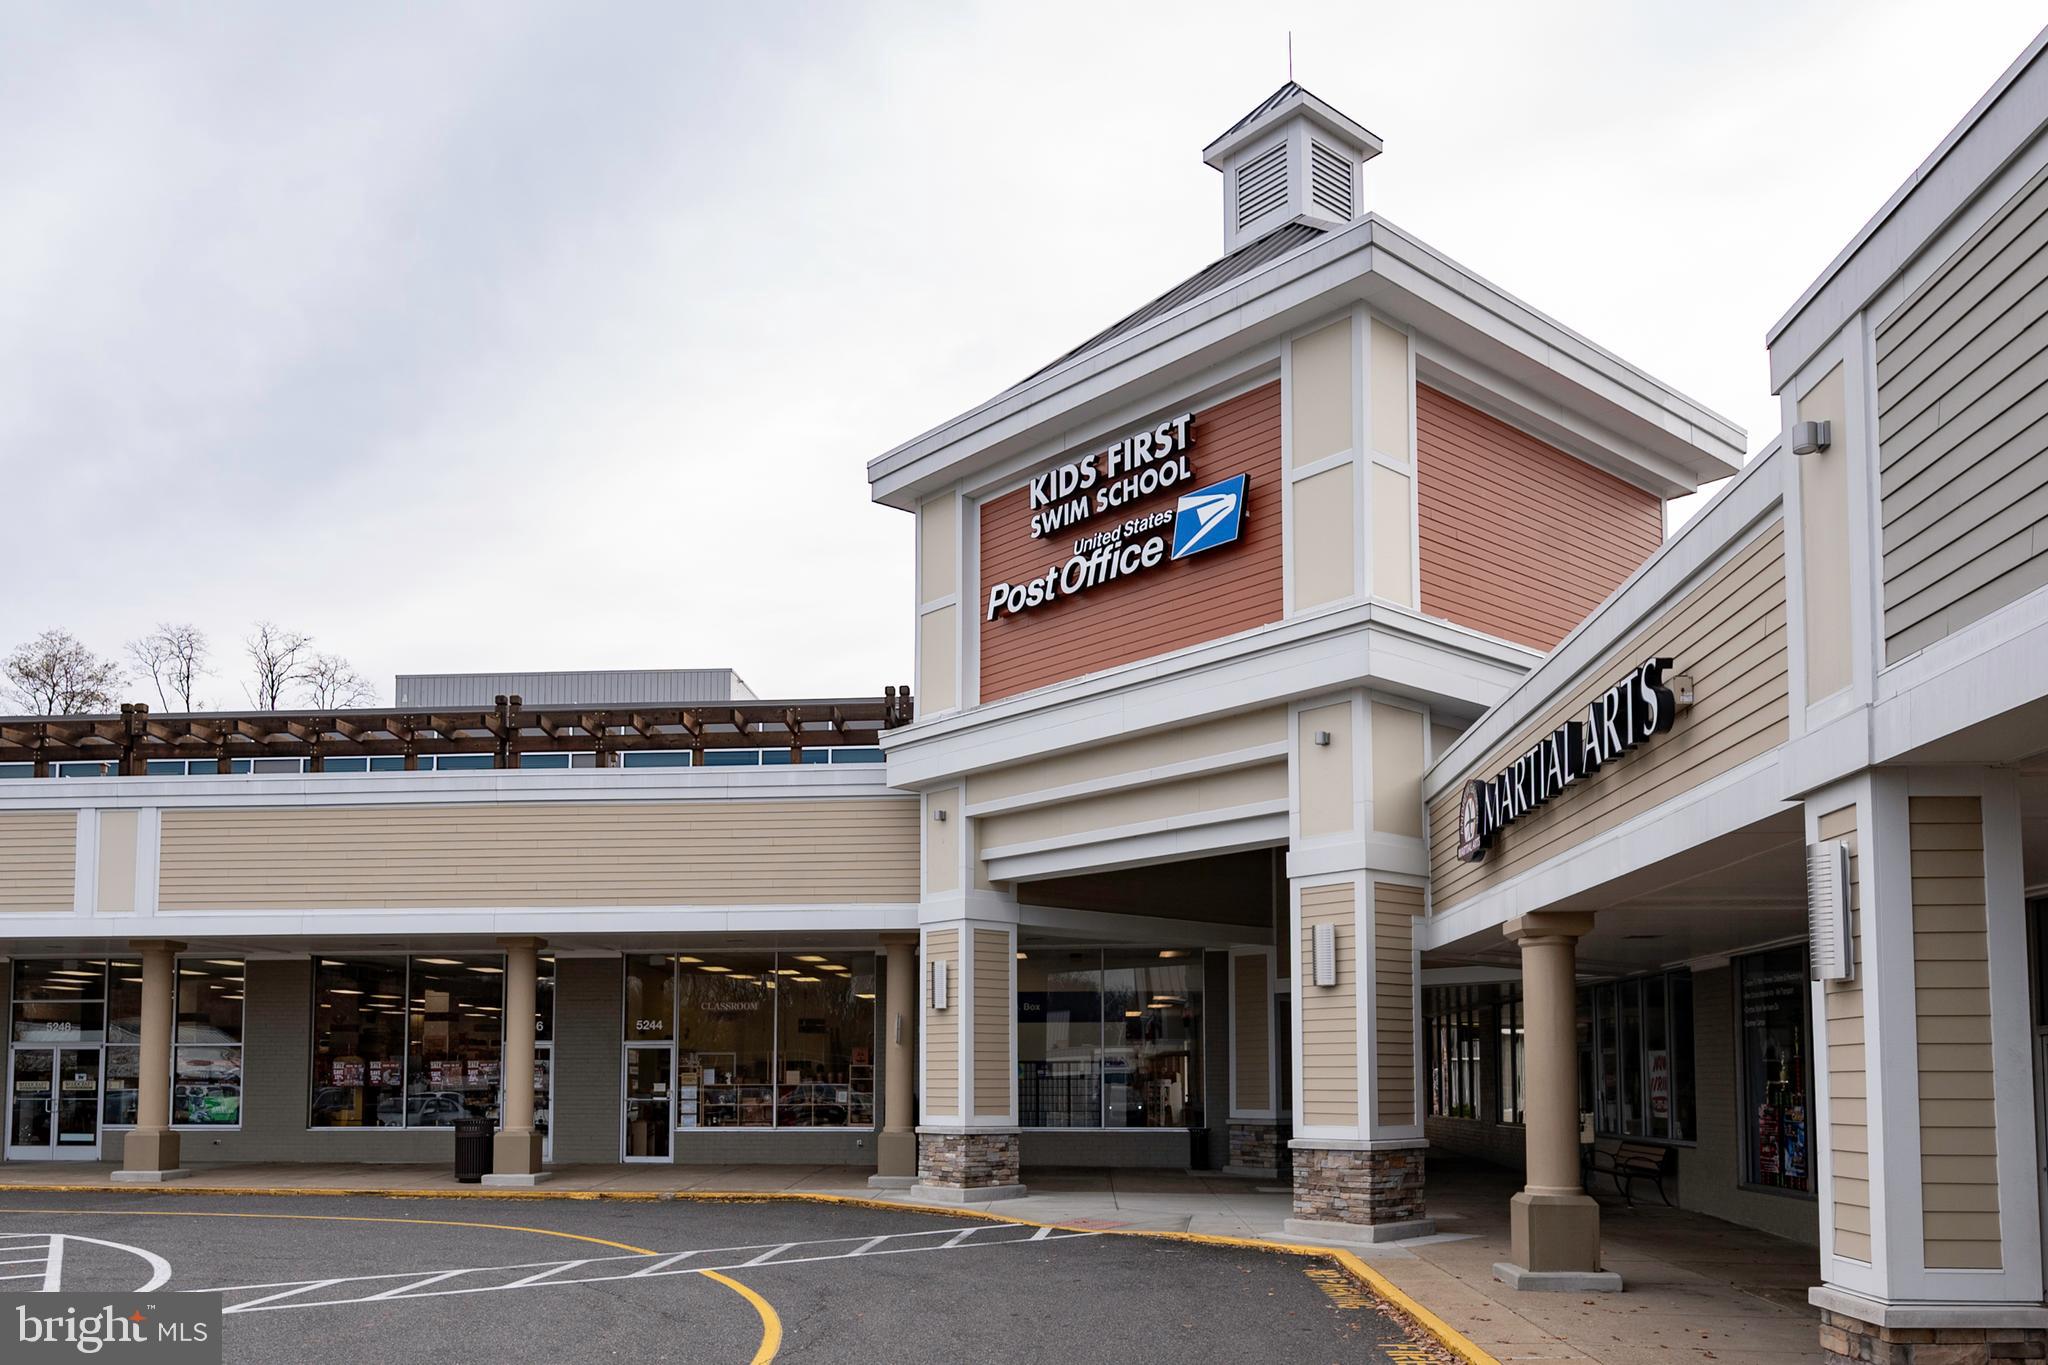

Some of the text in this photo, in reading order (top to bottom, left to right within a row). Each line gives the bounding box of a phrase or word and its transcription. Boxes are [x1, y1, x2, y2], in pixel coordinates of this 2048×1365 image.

[1030, 413, 1194, 509] KIDS FIRST
[1030, 456, 1192, 538] SWIM SCHOOL
[1073, 509, 1173, 556] United States
[987, 536, 1164, 621] Post Office
[1483, 720, 1576, 836] MARTIAL
[1583, 658, 1664, 773] ARTS
[701, 1002, 758, 1011] CLASSROOM
[1023, 1002, 1040, 1011] Box
[46, 1021, 72, 1032] 5248
[536, 1021, 544, 1031] 6
[636, 1020, 663, 1031] 5244
